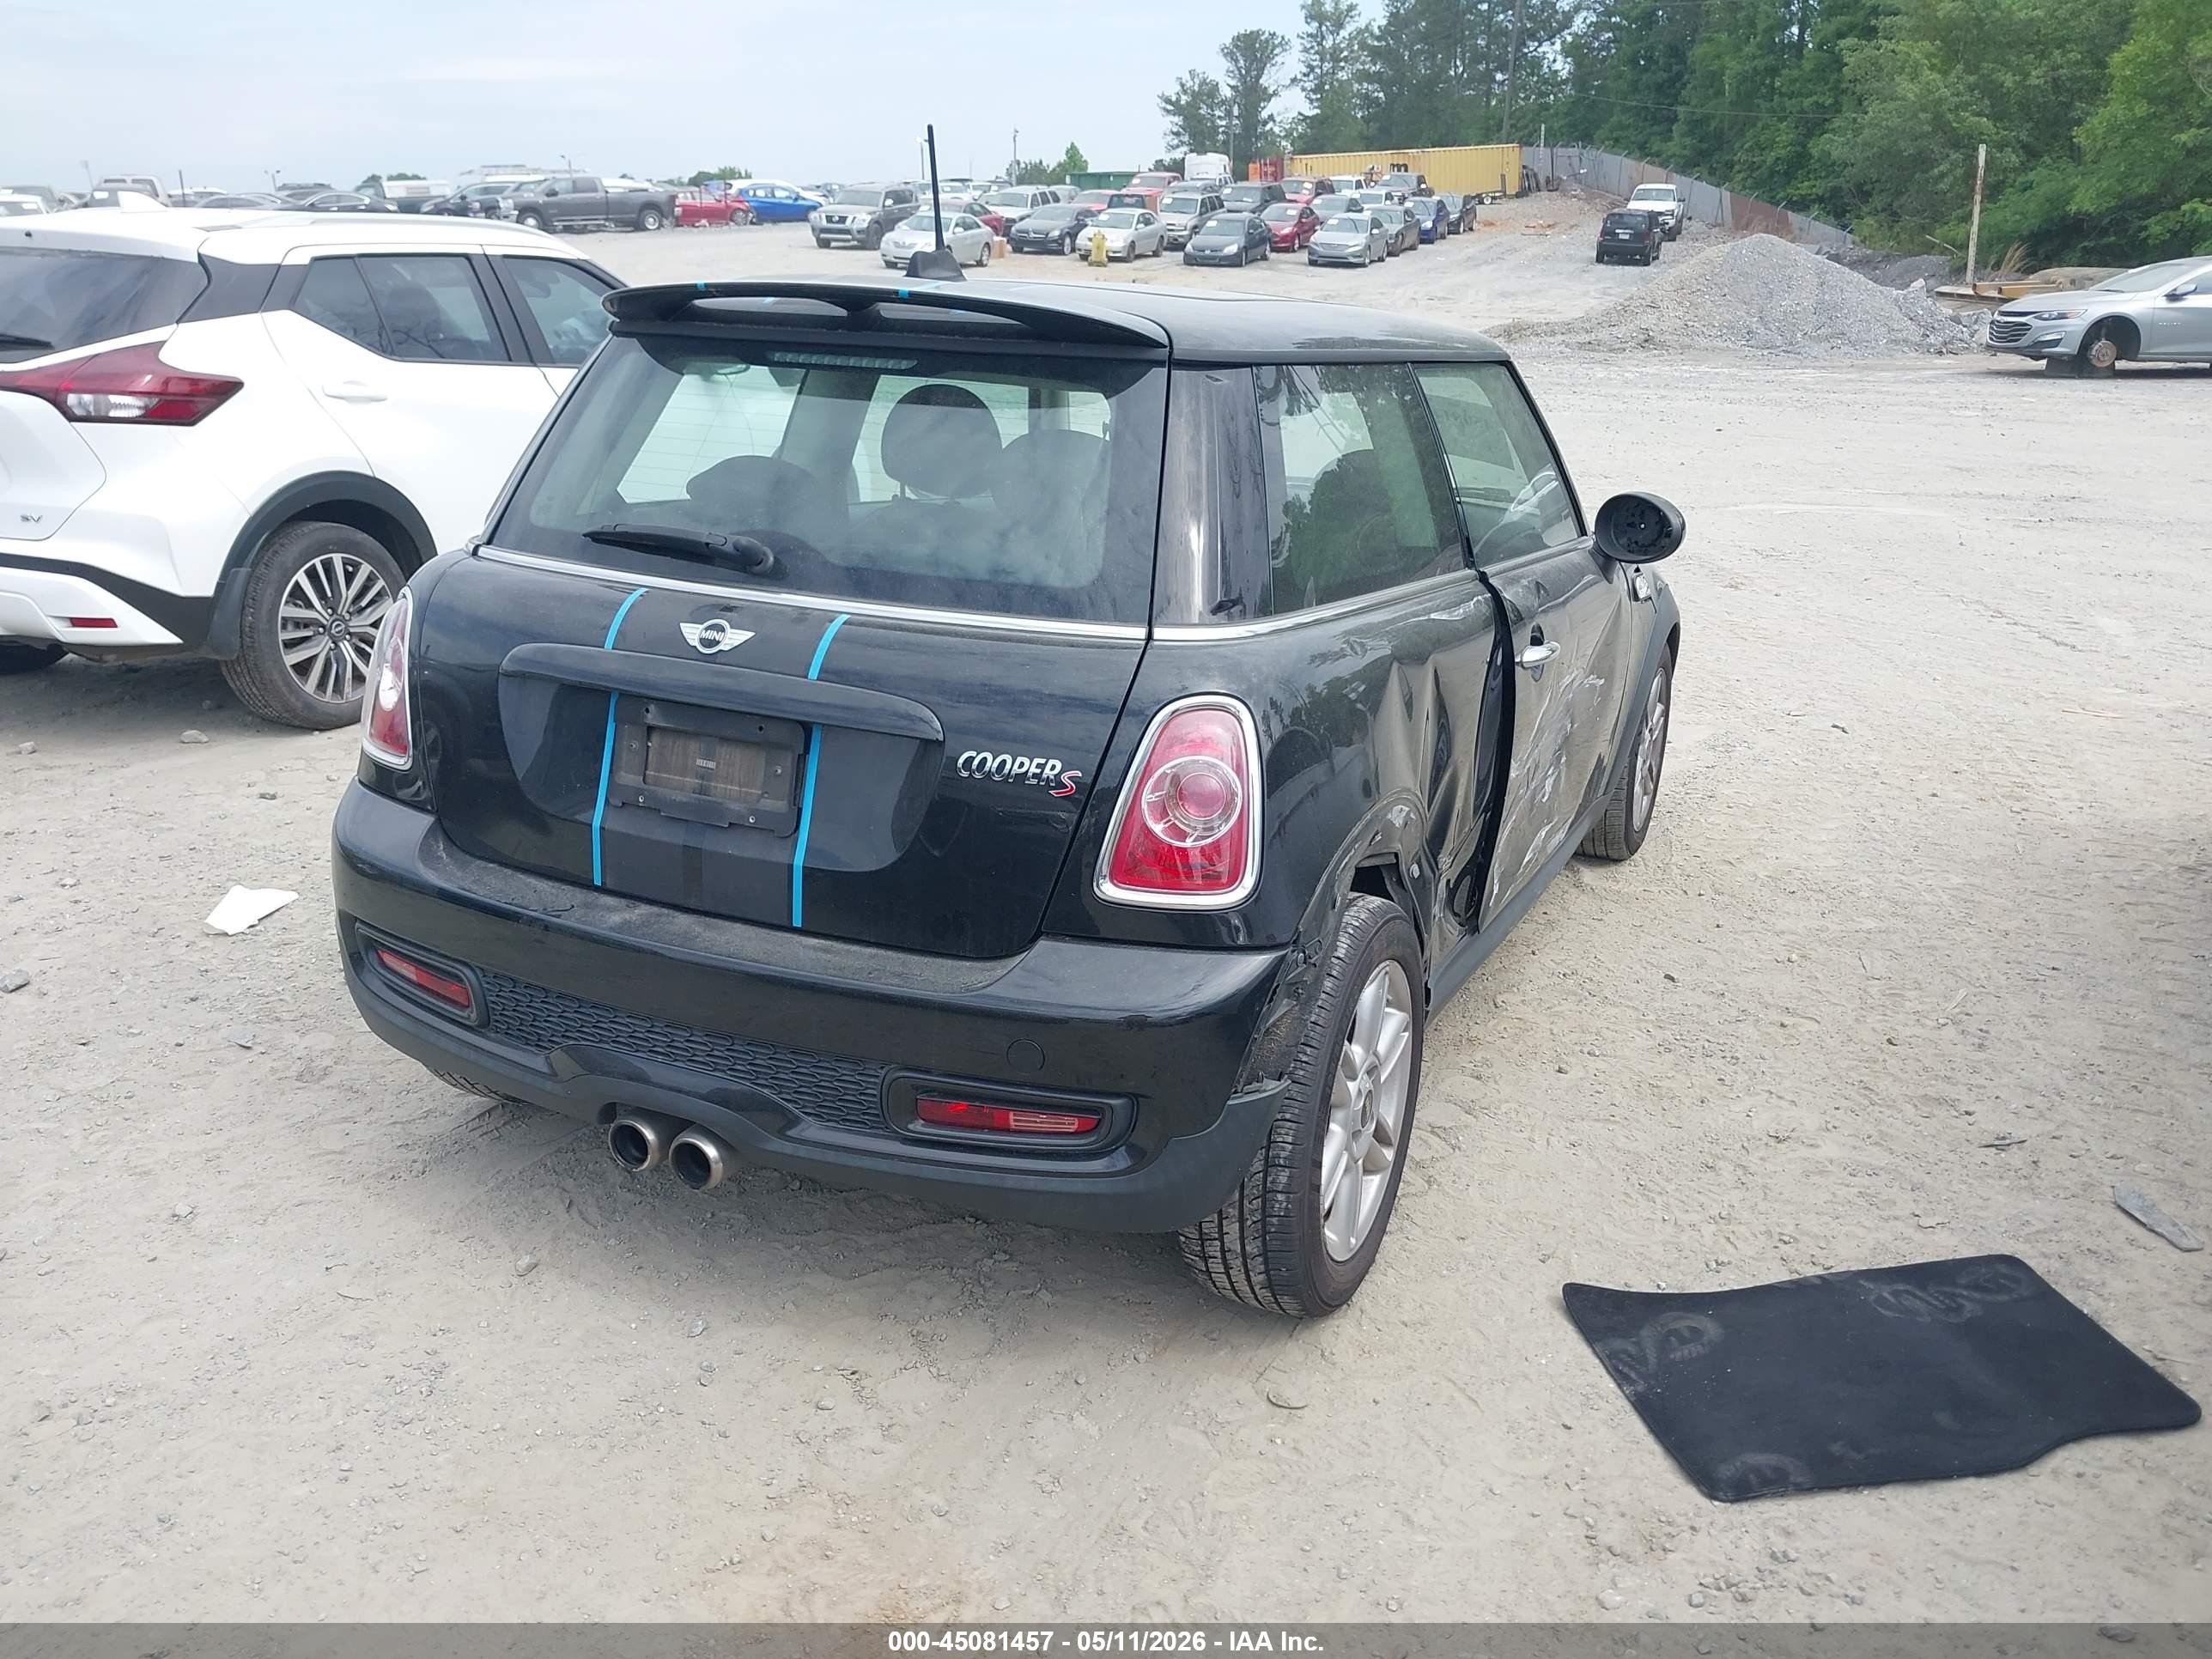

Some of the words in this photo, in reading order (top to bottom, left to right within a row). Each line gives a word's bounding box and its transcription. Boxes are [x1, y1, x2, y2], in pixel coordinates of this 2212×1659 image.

[20, 514, 43, 523] SV
[700, 629, 725, 641] MINI
[957, 750, 1062, 787] COOPER
[1048, 770, 1082, 797] S
